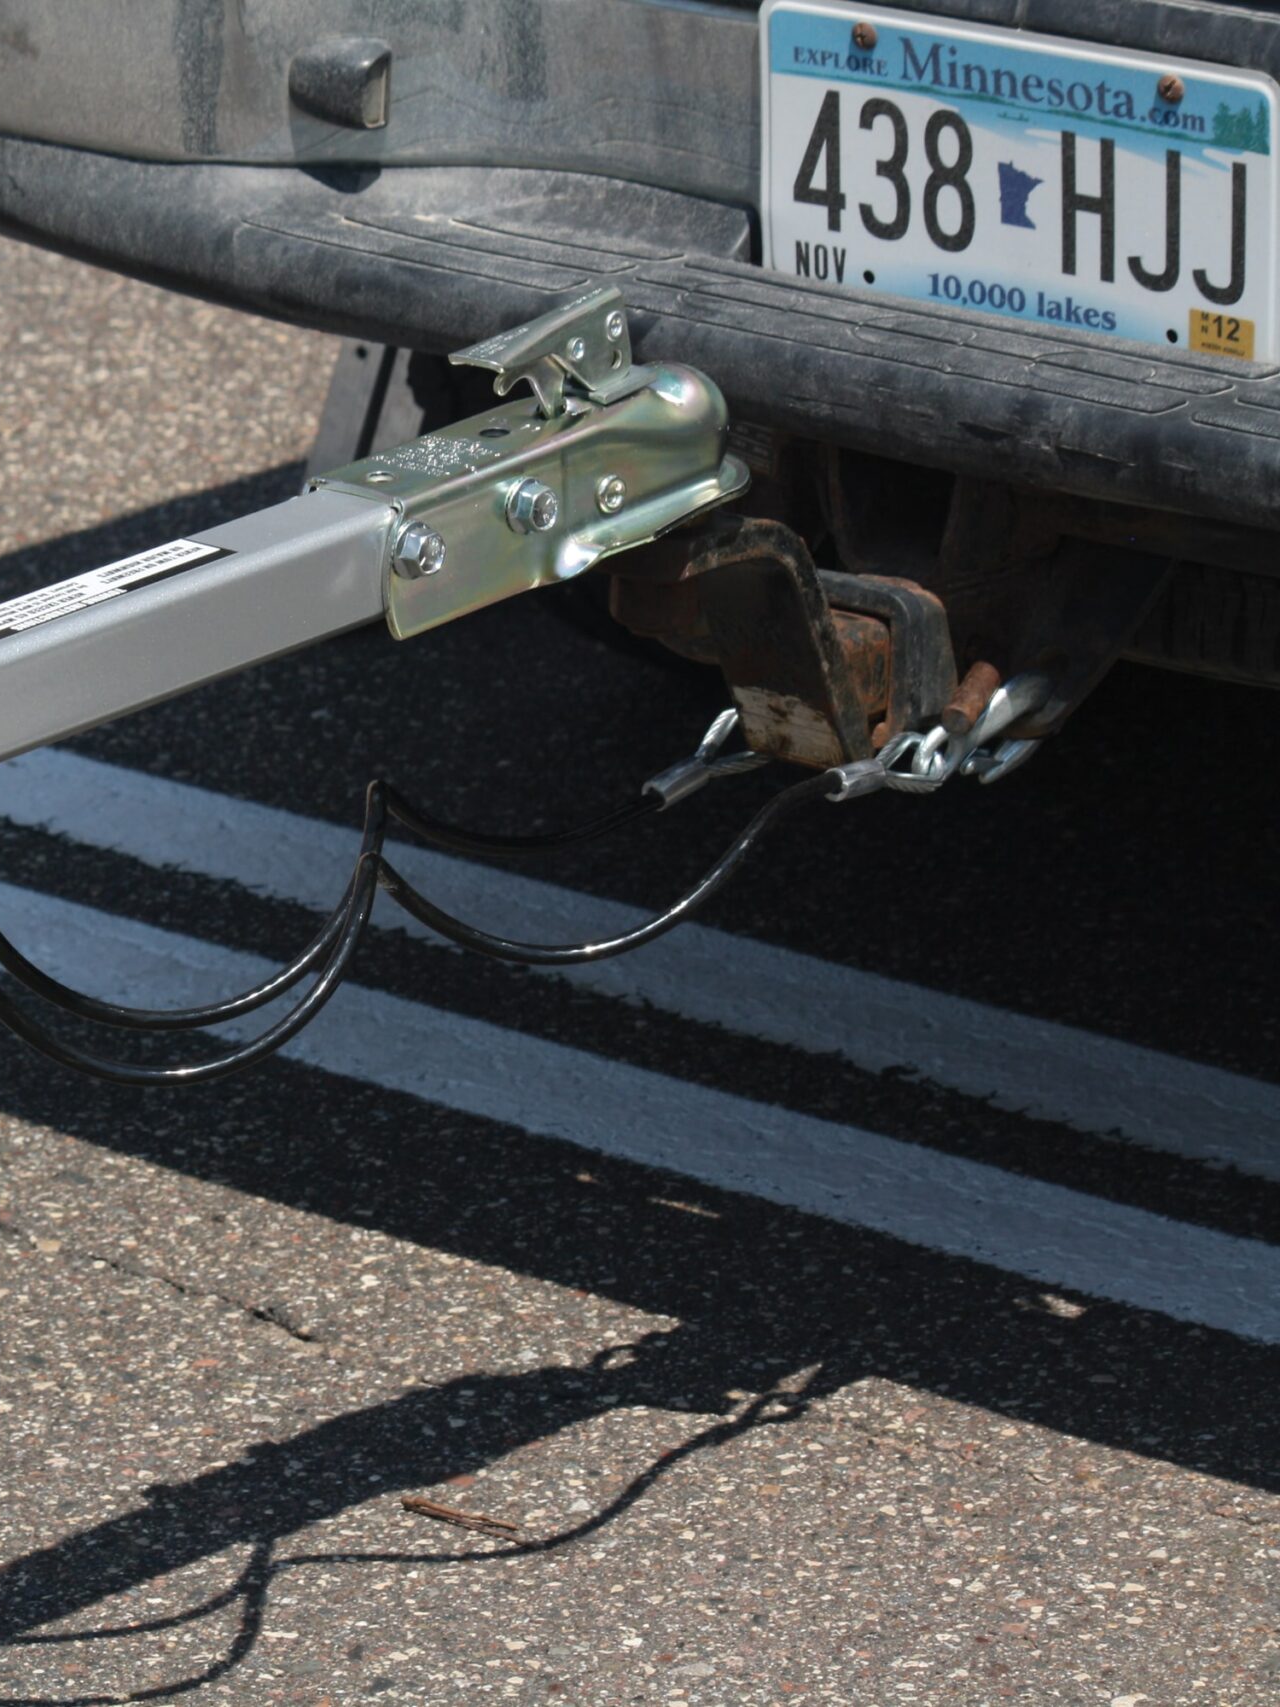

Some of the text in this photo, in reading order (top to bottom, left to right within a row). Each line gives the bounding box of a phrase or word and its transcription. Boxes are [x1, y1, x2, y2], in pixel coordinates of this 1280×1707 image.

[793, 37, 1206, 133] EXPLORE Minnesota.com
[793, 89, 1246, 306] 438 HJJ
[796, 241, 846, 284] NOV
[927, 273, 1117, 331] 10,000 lakes
[1212, 315, 1240, 342] 12
